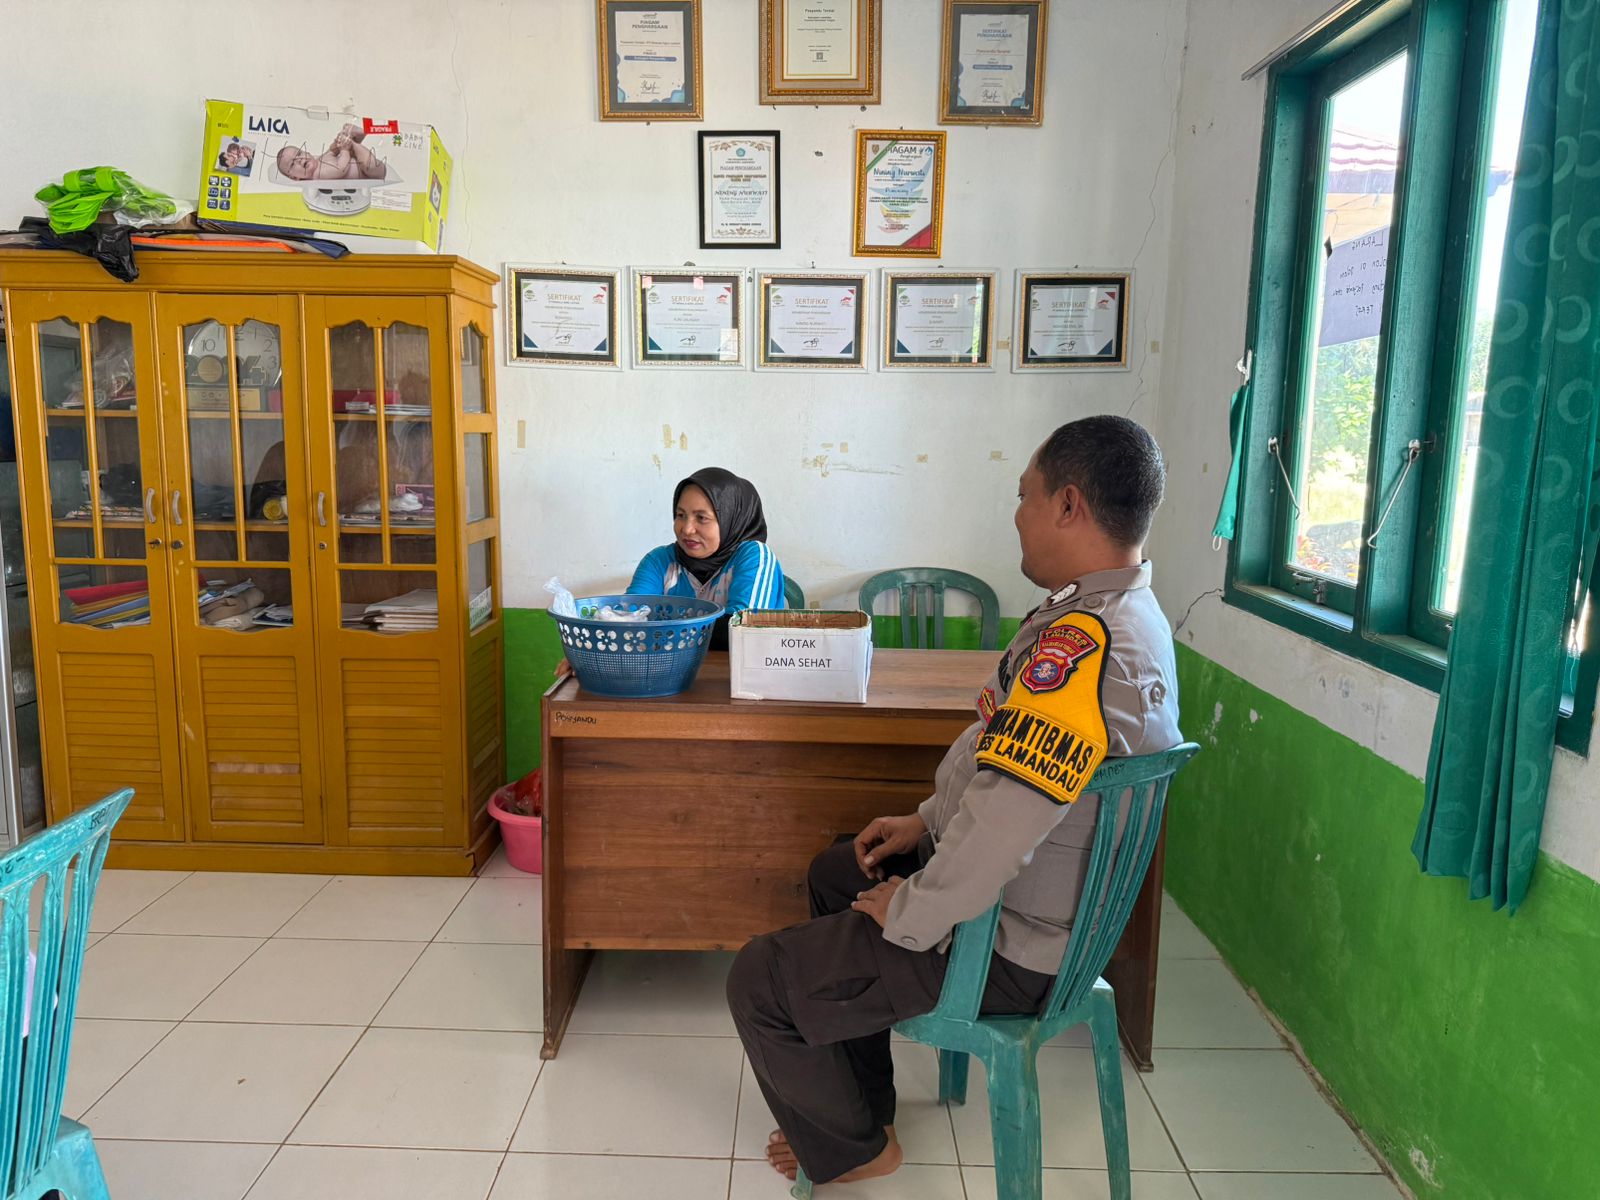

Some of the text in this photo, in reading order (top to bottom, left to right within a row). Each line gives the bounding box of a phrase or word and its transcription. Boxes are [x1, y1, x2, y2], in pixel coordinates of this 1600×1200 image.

[248, 115, 290, 135] LAICA
[547, 293, 582, 302] SERTIFIKAT
[671, 295, 705, 303] SERTIFIKAT
[1051, 301, 1087, 309] SERTIFIKAT
[202, 339, 216, 352] 10
[781, 639, 816, 648] KOTAK
[765, 657, 832, 668] DANA SEHAT
[988, 708, 1093, 774] KAMTIBMAS
[994, 738, 1079, 792] LAMANDAU
